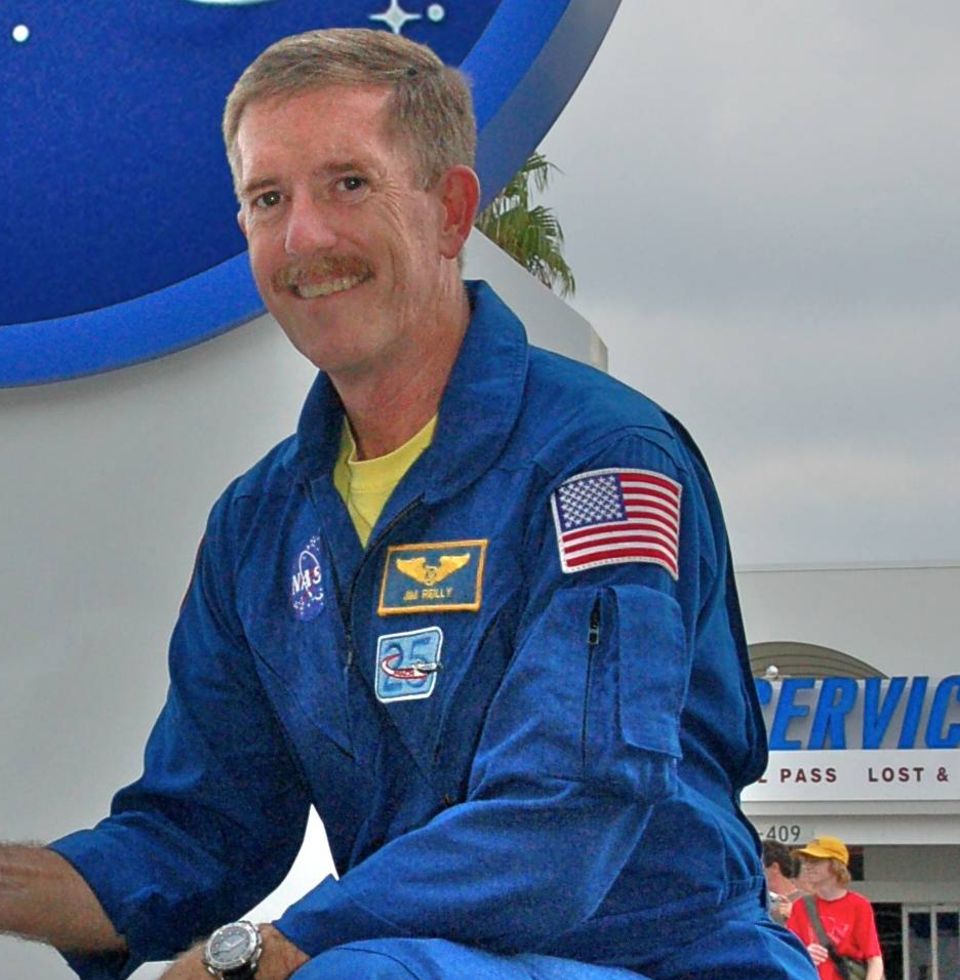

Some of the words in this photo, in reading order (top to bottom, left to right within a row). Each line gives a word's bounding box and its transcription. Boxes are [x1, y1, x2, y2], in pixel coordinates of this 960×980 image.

[780, 767, 837, 783] PASS
[868, 767, 924, 782] LOST
[936, 767, 949, 782] &
